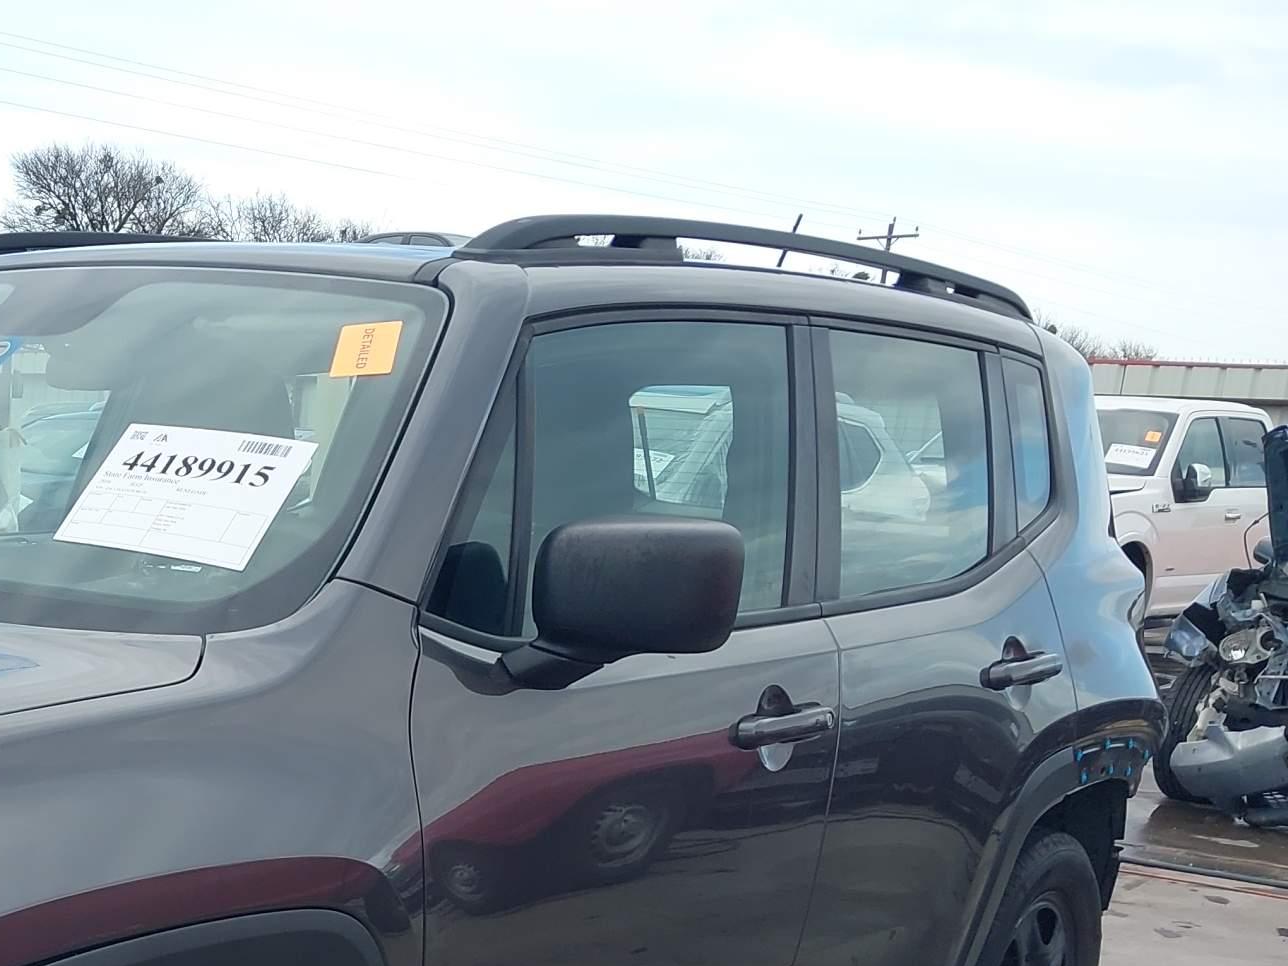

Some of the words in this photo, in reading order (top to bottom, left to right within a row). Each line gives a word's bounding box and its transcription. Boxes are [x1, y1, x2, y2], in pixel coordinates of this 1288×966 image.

[355, 327, 377, 369] DETAILED
[121, 450, 277, 488] 44189915
[122, 472, 143, 481] Farm
